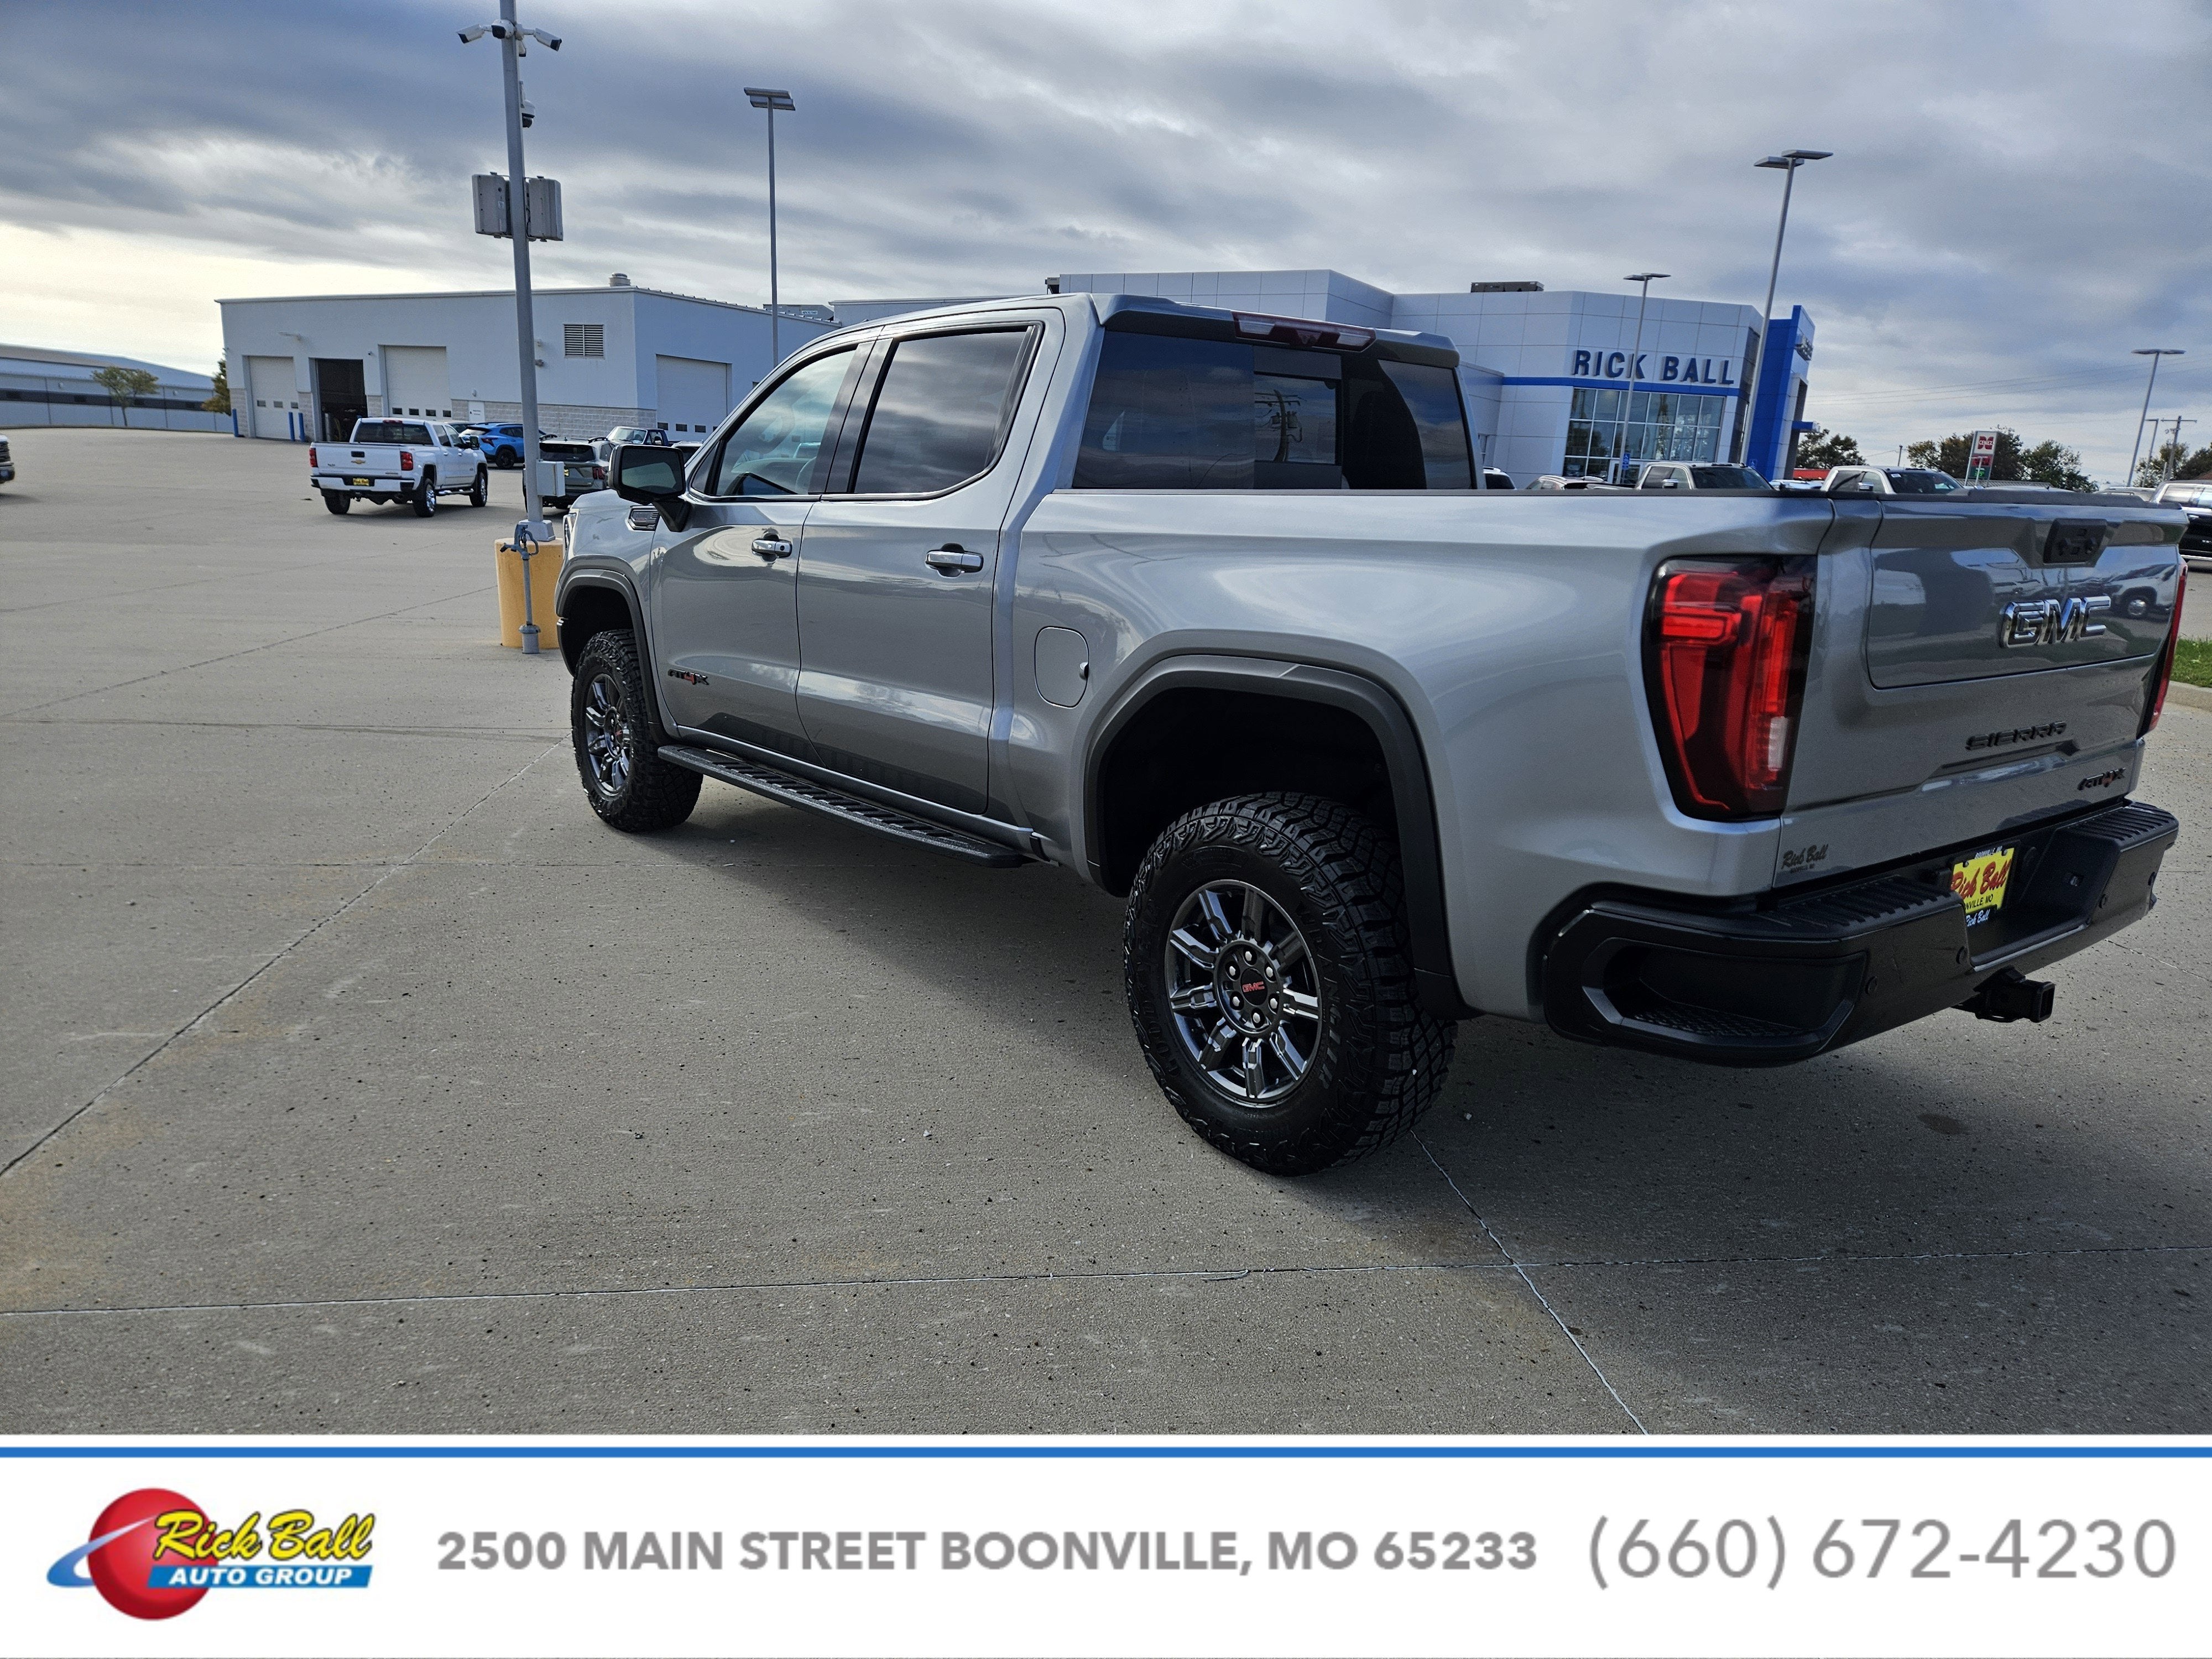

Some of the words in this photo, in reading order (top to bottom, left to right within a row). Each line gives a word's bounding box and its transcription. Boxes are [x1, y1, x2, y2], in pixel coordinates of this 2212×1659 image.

[1571, 349, 1647, 379] RICK
[1660, 356, 1734, 384] BALL
[1999, 596, 2111, 648] GMC
[1966, 721, 2067, 750] SIERRA
[1781, 848, 1806, 870] Rick
[1806, 844, 1829, 863] Ball
[1950, 867, 1980, 900] Rick
[1980, 860, 2012, 895] Ball
[1985, 894, 1994, 903] MO
[1977, 909, 1990, 923] Ball
[1242, 981, 1265, 993] GMC
